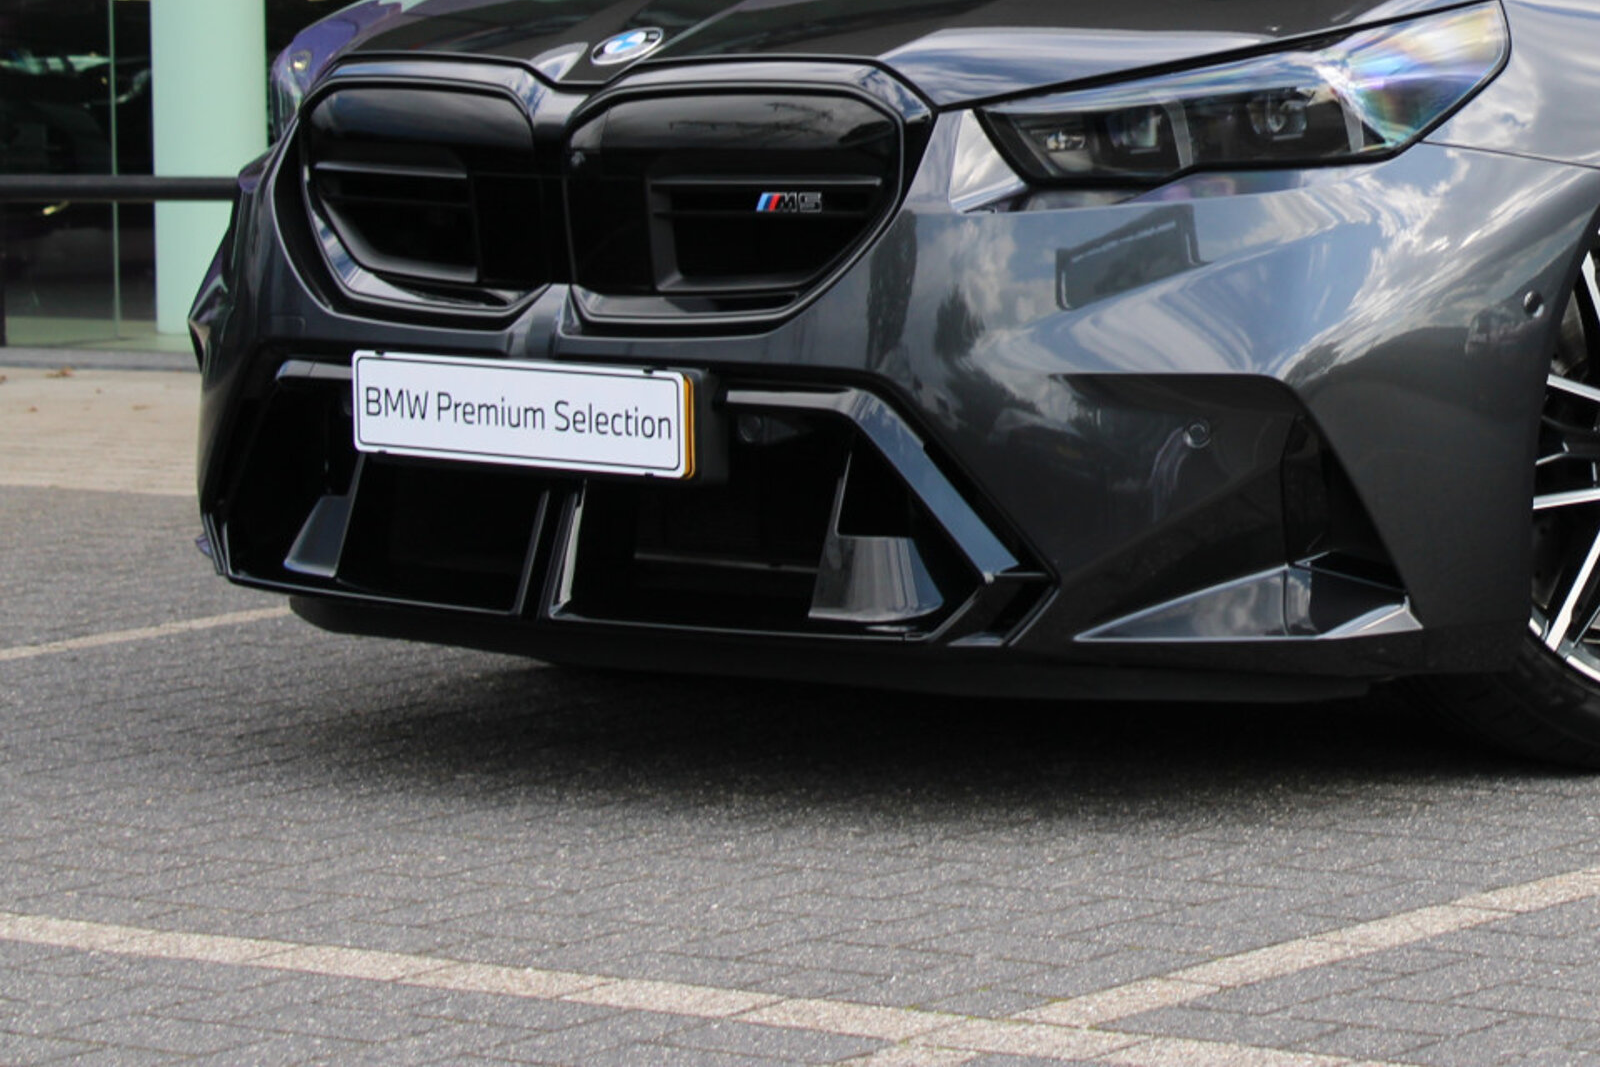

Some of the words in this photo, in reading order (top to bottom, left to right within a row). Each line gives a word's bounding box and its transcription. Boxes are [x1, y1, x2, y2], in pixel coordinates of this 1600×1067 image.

[365, 387, 429, 420] BMW
[437, 392, 546, 430] Premium
[554, 400, 673, 440] Selection
